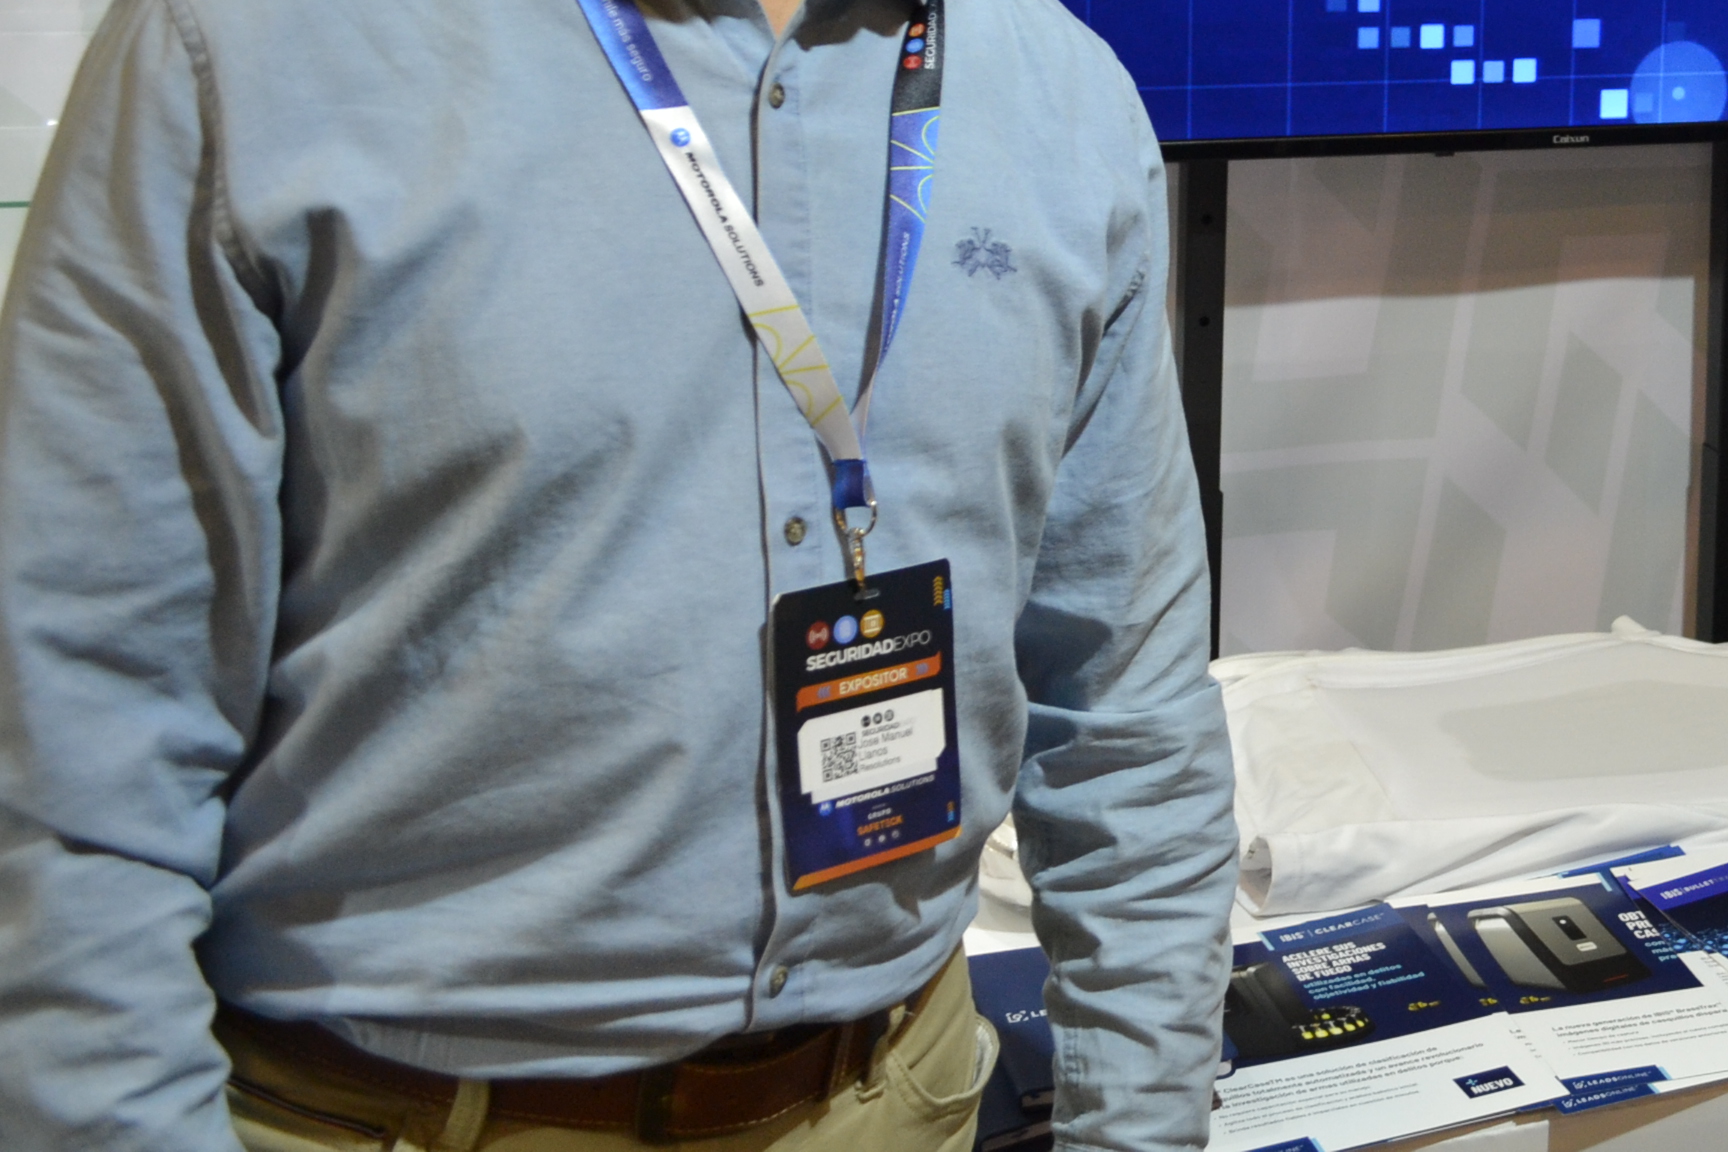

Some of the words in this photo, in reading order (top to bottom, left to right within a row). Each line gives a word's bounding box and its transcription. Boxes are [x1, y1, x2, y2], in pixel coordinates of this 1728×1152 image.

[685, 152, 729, 224] MOTOROLA
[723, 224, 765, 288] SOLUTIONS
[839, 667, 909, 695] EXPOSITOR
[835, 786, 890, 809] MOTOROLA
[1470, 1077, 1514, 1095] NUEVO
